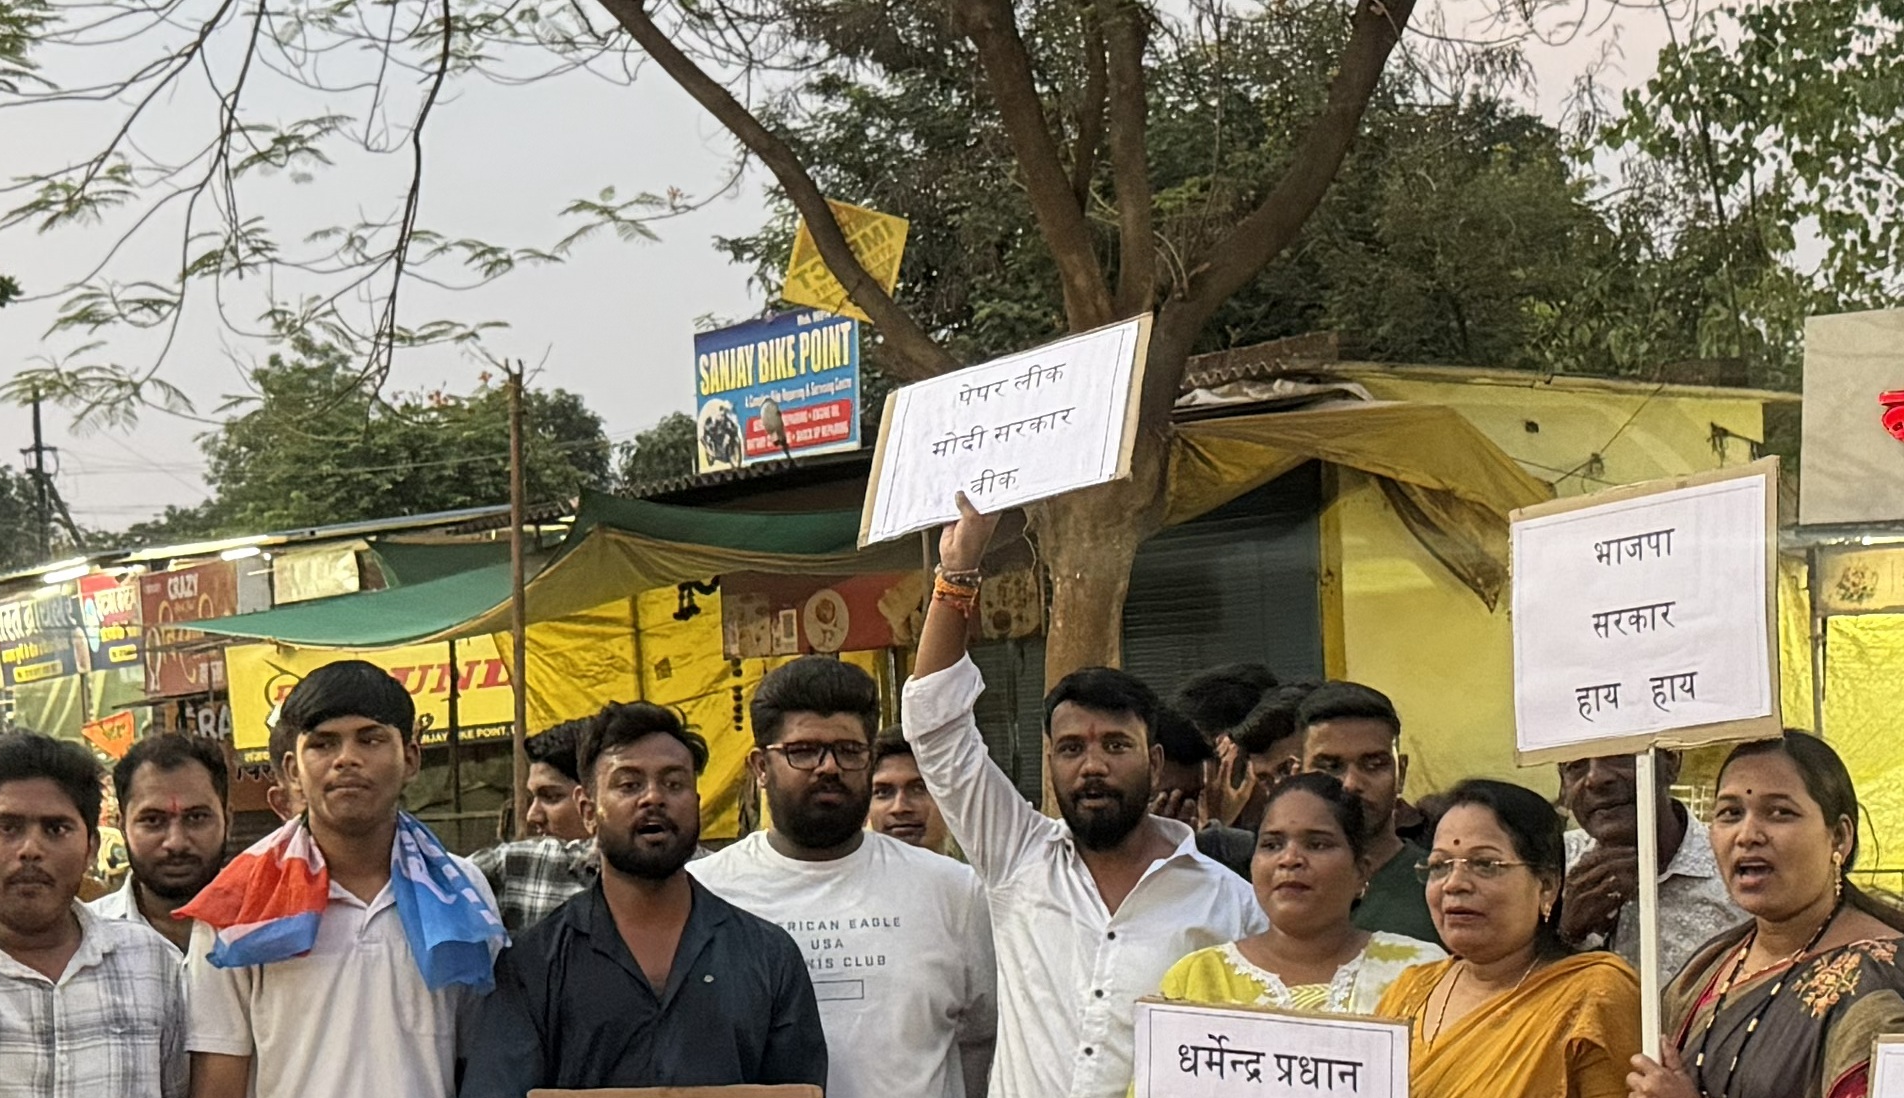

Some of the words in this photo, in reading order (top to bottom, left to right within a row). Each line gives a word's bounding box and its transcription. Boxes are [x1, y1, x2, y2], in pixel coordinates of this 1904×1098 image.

[699, 344, 755, 395] SANJAY
[757, 334, 796, 383] BIKE
[799, 321, 852, 375] POINT
[959, 379, 1009, 406] पेपर
[1014, 363, 1067, 391] लीक
[932, 425, 988, 457] मोदी
[994, 407, 1077, 443] सरकार
[970, 468, 1019, 496] वीक
[1594, 528, 1676, 566] भाजपा
[1592, 601, 1676, 639] सरकार
[390, 658, 511, 695] UNL
[1575, 682, 1622, 722] हाय
[1648, 671, 1698, 712] हाय
[778, 920, 840, 931] RICAN
[811, 938, 844, 950] USA
[806, 957, 834, 969] NIS
[843, 955, 886, 967] CLUB
[1178, 1033, 1266, 1084] धर्मेन्द्र
[1273, 1053, 1364, 1093] प्रधान
